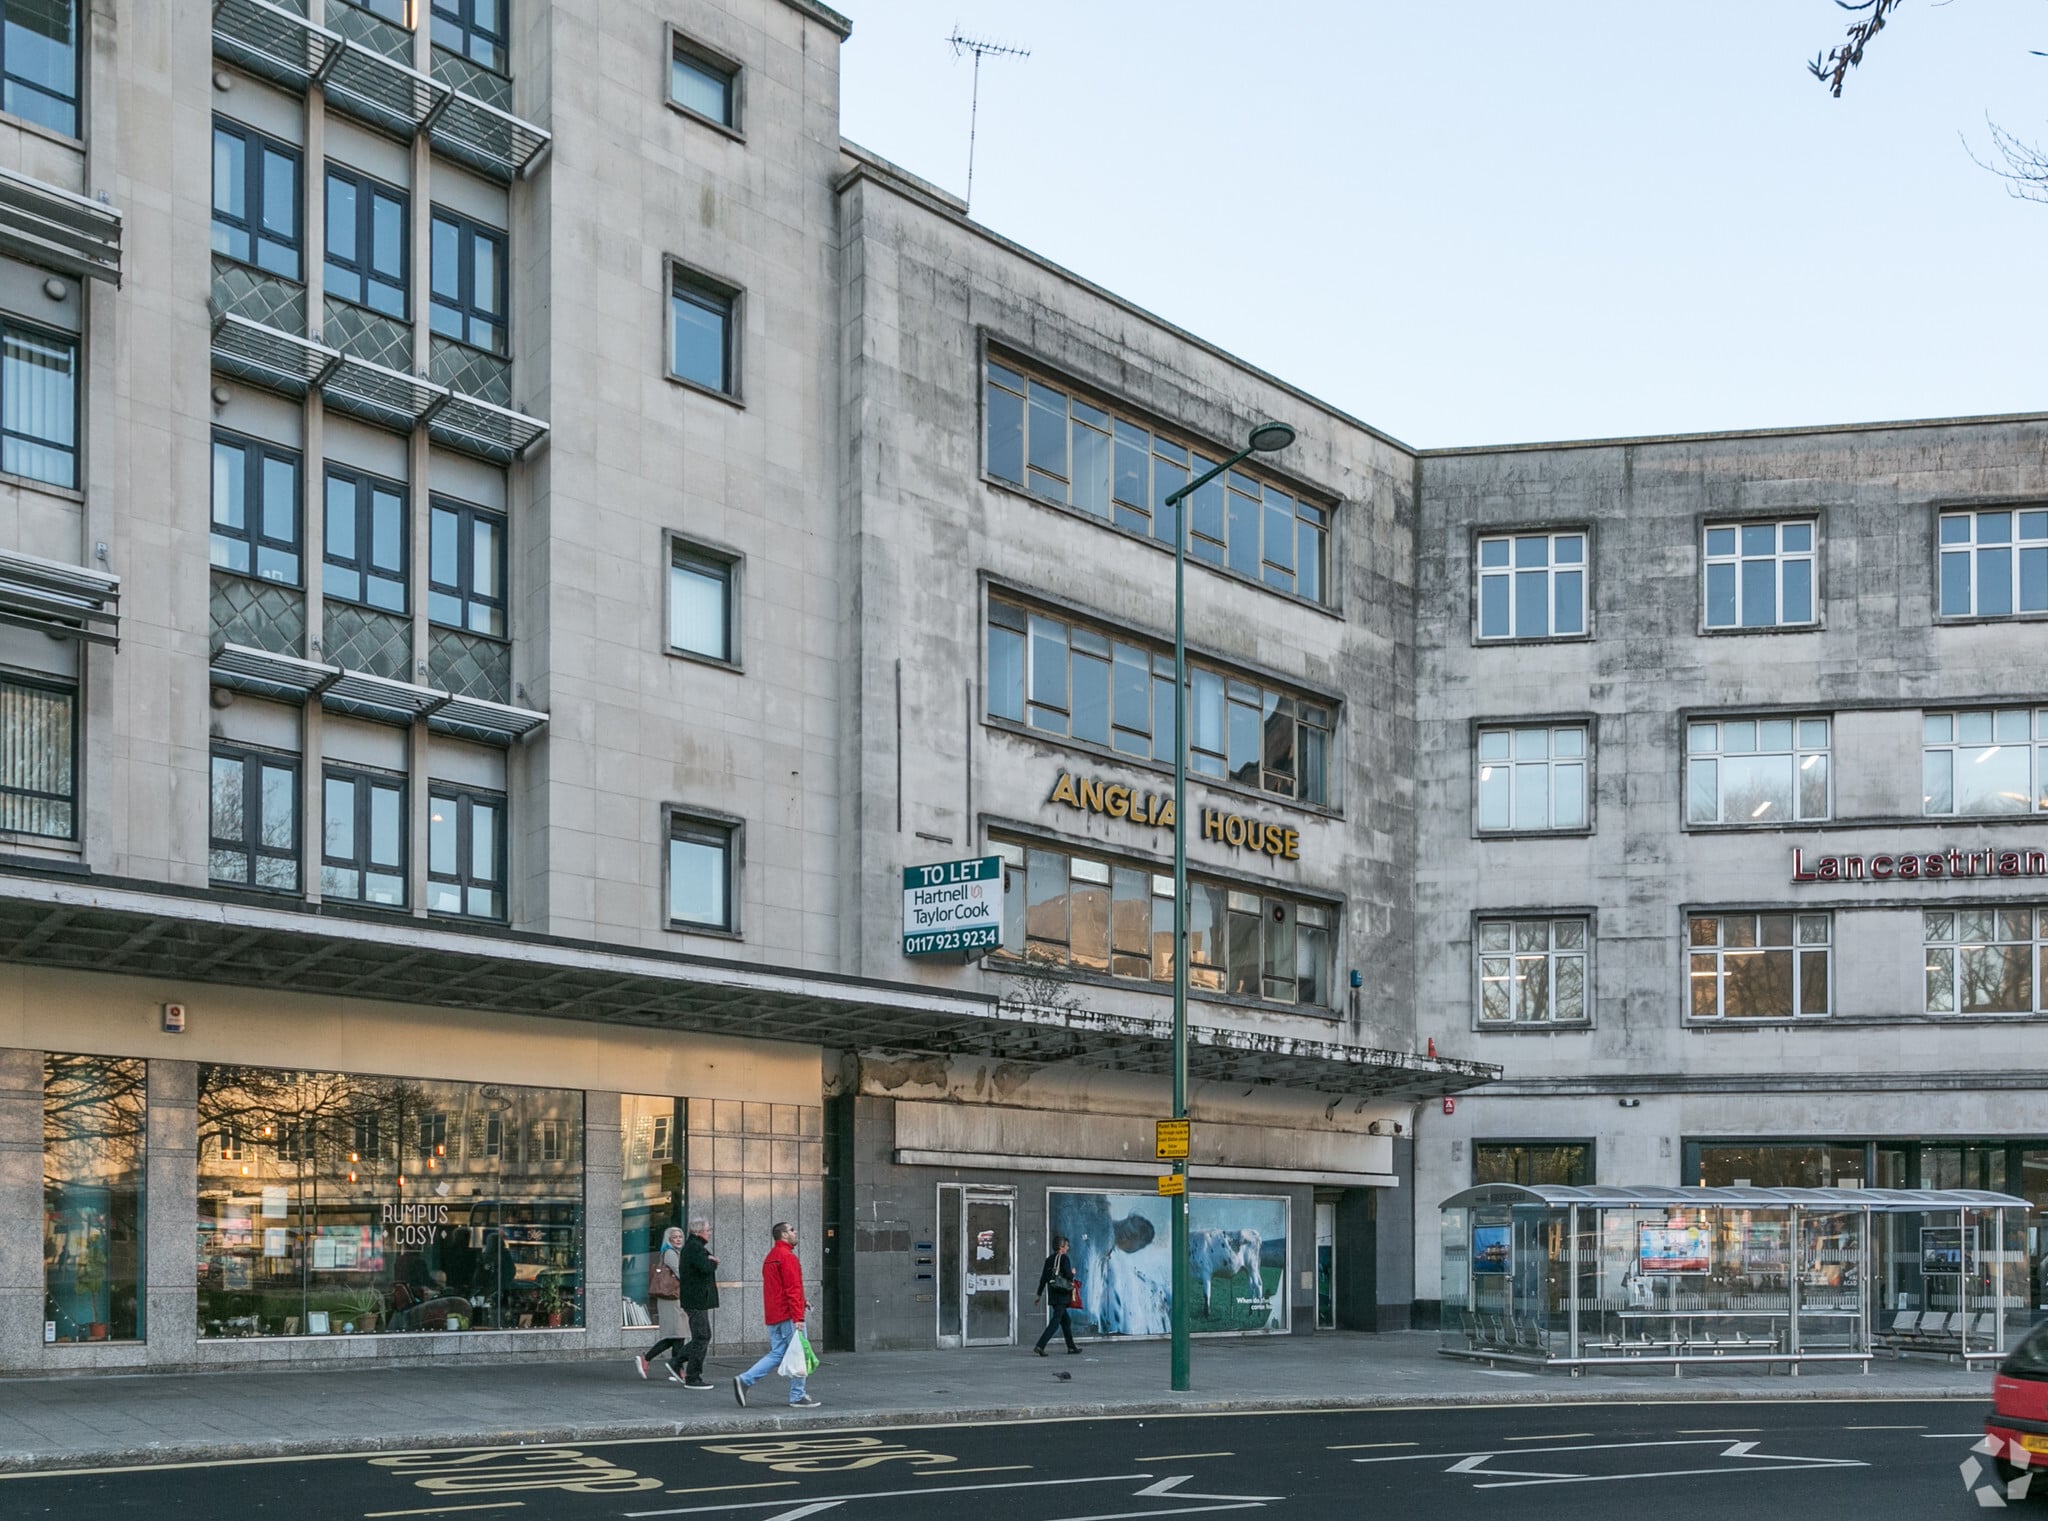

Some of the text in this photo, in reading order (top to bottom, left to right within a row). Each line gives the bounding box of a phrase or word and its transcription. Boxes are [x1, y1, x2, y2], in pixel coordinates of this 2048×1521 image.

[1052, 772, 1300, 860] ANGLIA HOUSE
[920, 860, 984, 885] TO LET
[1792, 847, 2047, 881] Lancastrian
[914, 884, 968, 906] Hartnell
[913, 901, 989, 927] Taylor Cook
[906, 929, 996, 953] 0117 923 9234
[383, 1204, 449, 1224] RUMPUS
[395, 1225, 437, 1245] COSY
[699, 1437, 959, 1473] BUS
[367, 1449, 664, 1496] STOP
